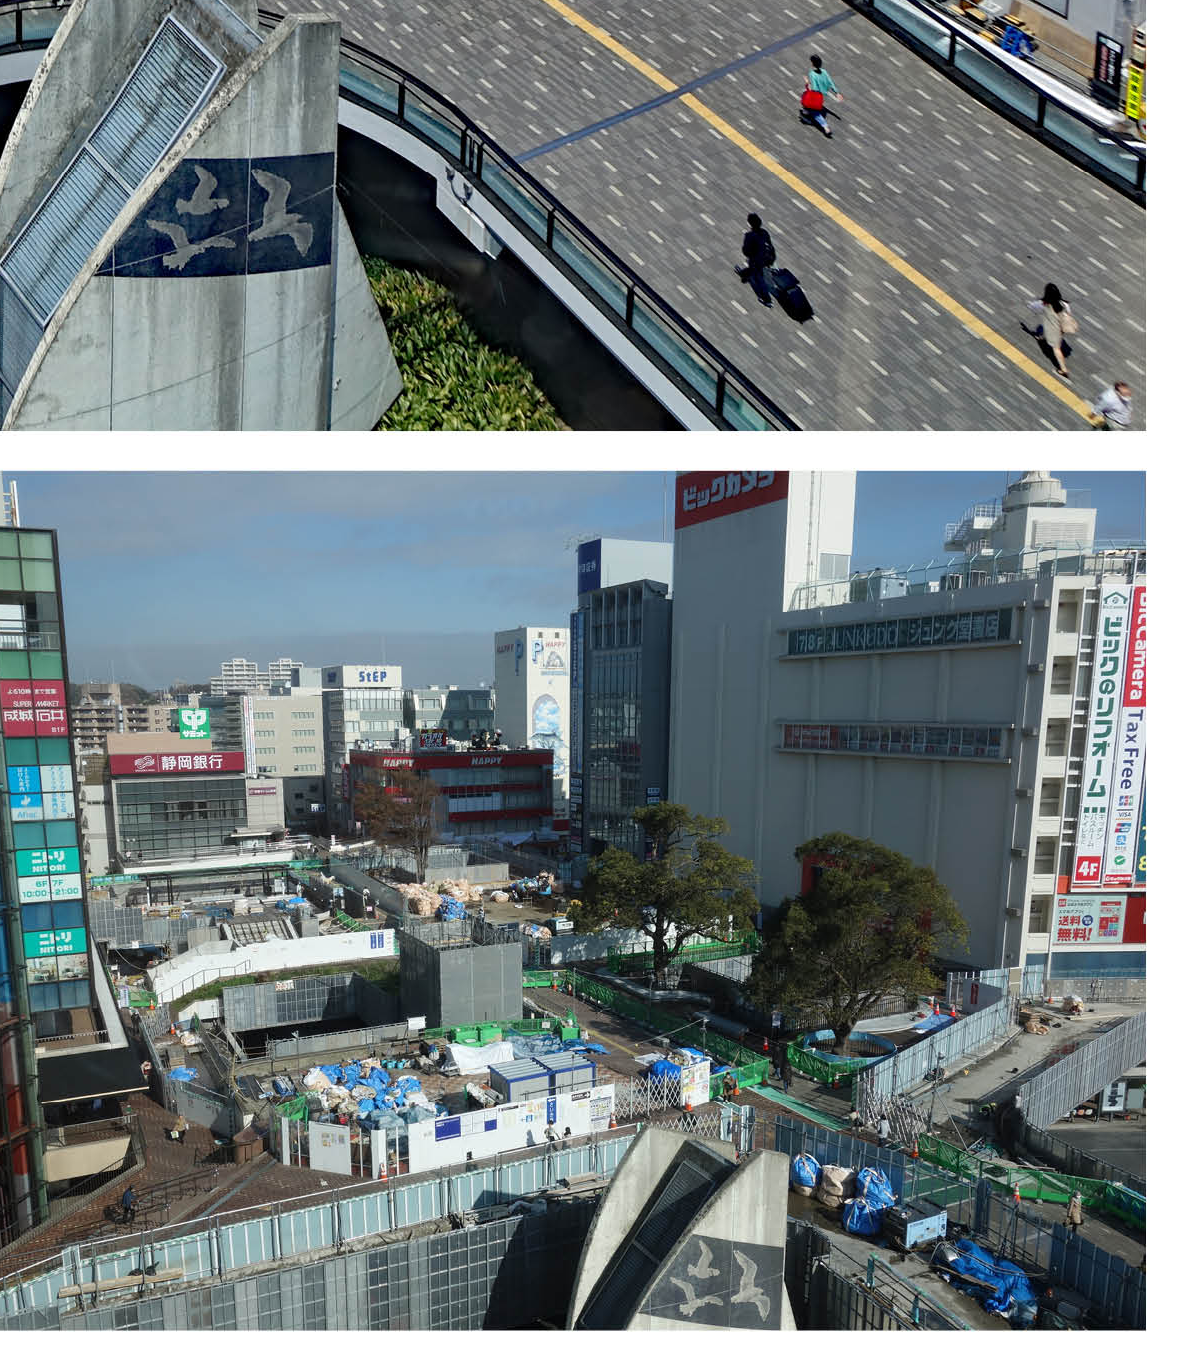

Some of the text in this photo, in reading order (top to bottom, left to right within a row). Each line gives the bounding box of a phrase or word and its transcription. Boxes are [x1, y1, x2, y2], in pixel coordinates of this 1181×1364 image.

[359, 670, 388, 683] StEP
[1086, 616, 1123, 798] ビックのリフォーム
[1120, 708, 1144, 790] Tax Free
[161, 754, 223, 771] 静岡銀行
[31, 849, 66, 865] ニトリ
[32, 863, 67, 873] NITORI
[1077, 860, 1099, 877] 4F
[39, 931, 72, 947] ニトリ
[39, 944, 73, 954] NITORI
